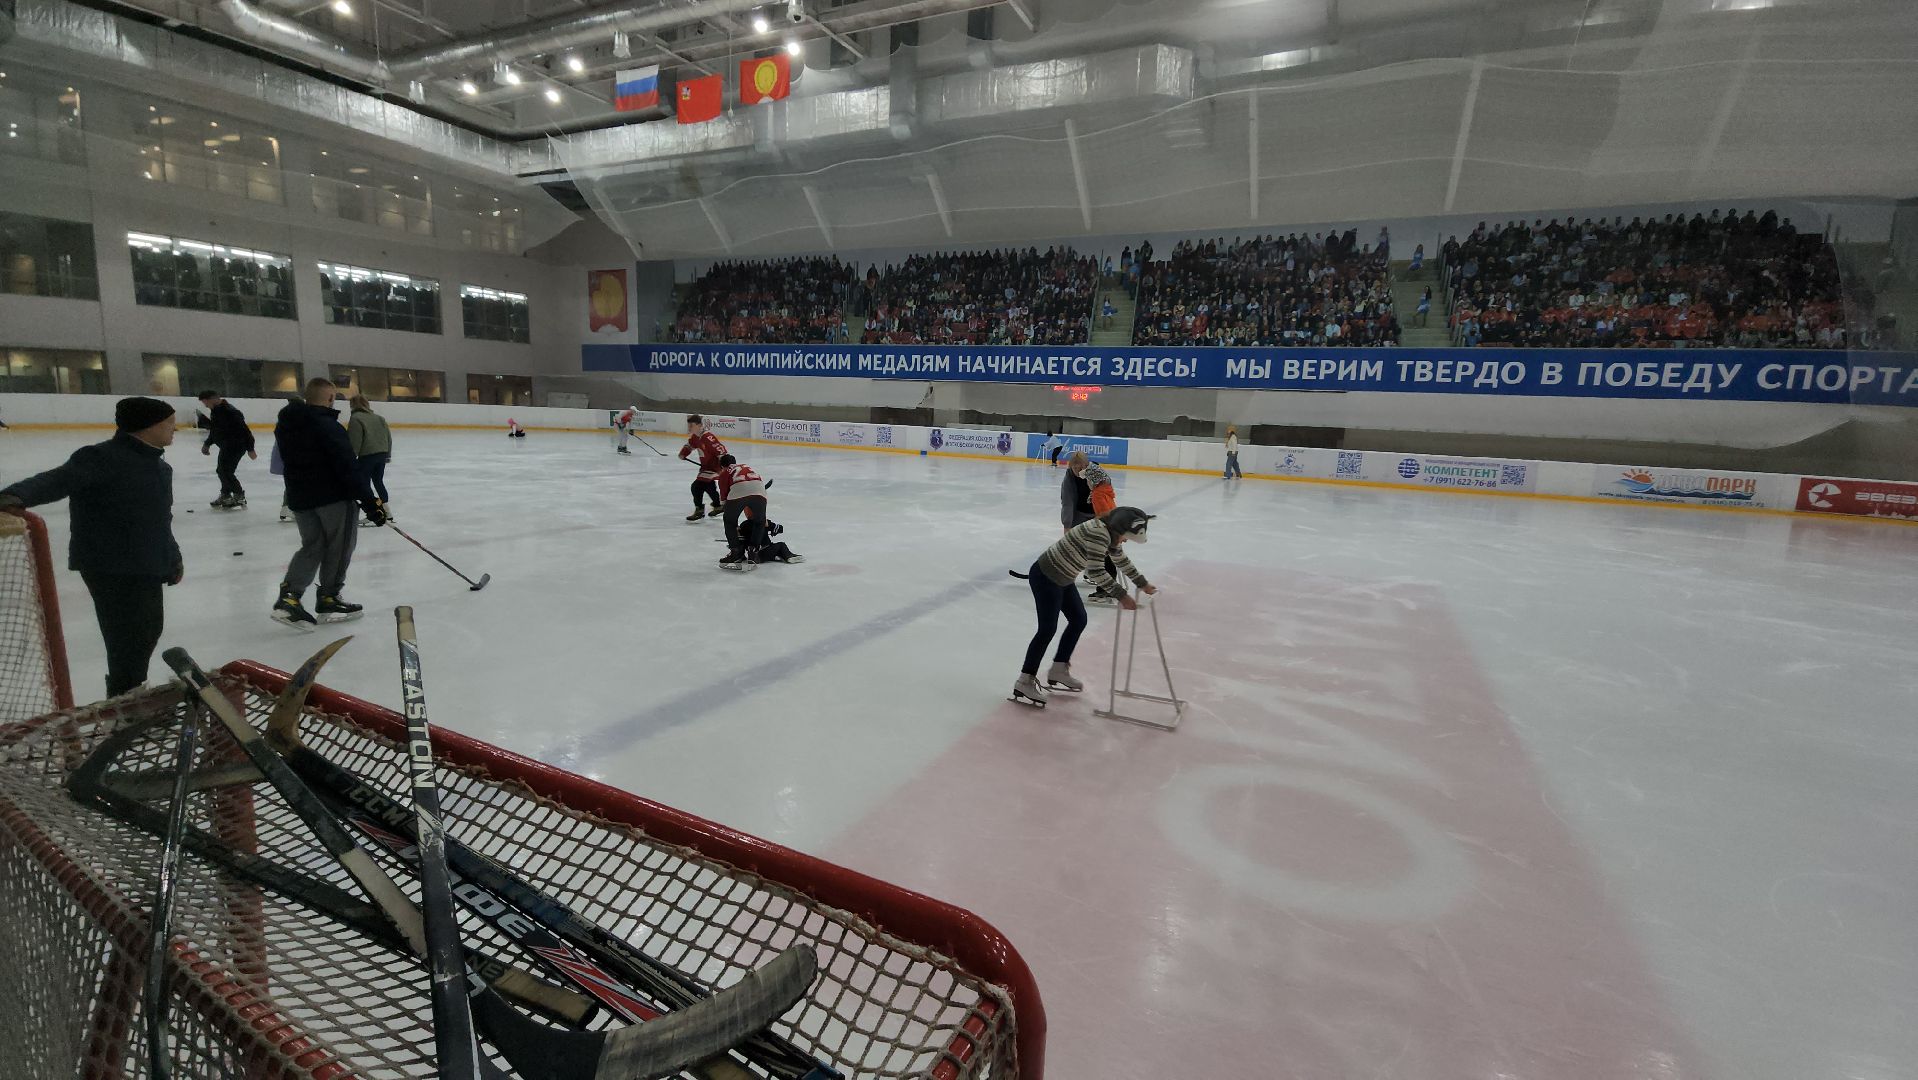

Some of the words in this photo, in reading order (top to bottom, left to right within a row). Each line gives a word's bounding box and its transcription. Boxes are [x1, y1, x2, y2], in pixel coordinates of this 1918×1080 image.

[649, 351, 706, 369] ДОРОГА
[711, 352, 721, 368] К
[724, 351, 851, 370] ОЛИМПИЙСКИМ
[858, 353, 950, 374] МЕДАЛЯМ
[958, 356, 1102, 376] НАЧИНАЕТСЯ
[1110, 356, 1198, 381] ЗДЕСЬ!
[1226, 358, 1272, 379] МЫ
[1282, 359, 1384, 381] ВЕРИМ
[1396, 361, 1526, 389] ТВЕРДО
[1540, 362, 1563, 385] В
[1577, 362, 1742, 393] ПОБЕДУ
[1423, 465, 1499, 479] КОМПЕТЕНТ
[1423, 475, 1434, 483] +7
[1435, 476, 1456, 486] (991)
[1457, 478, 1497, 488] 622-76-86
[403, 667, 436, 789] EASTON
[350, 788, 408, 828] CCM
